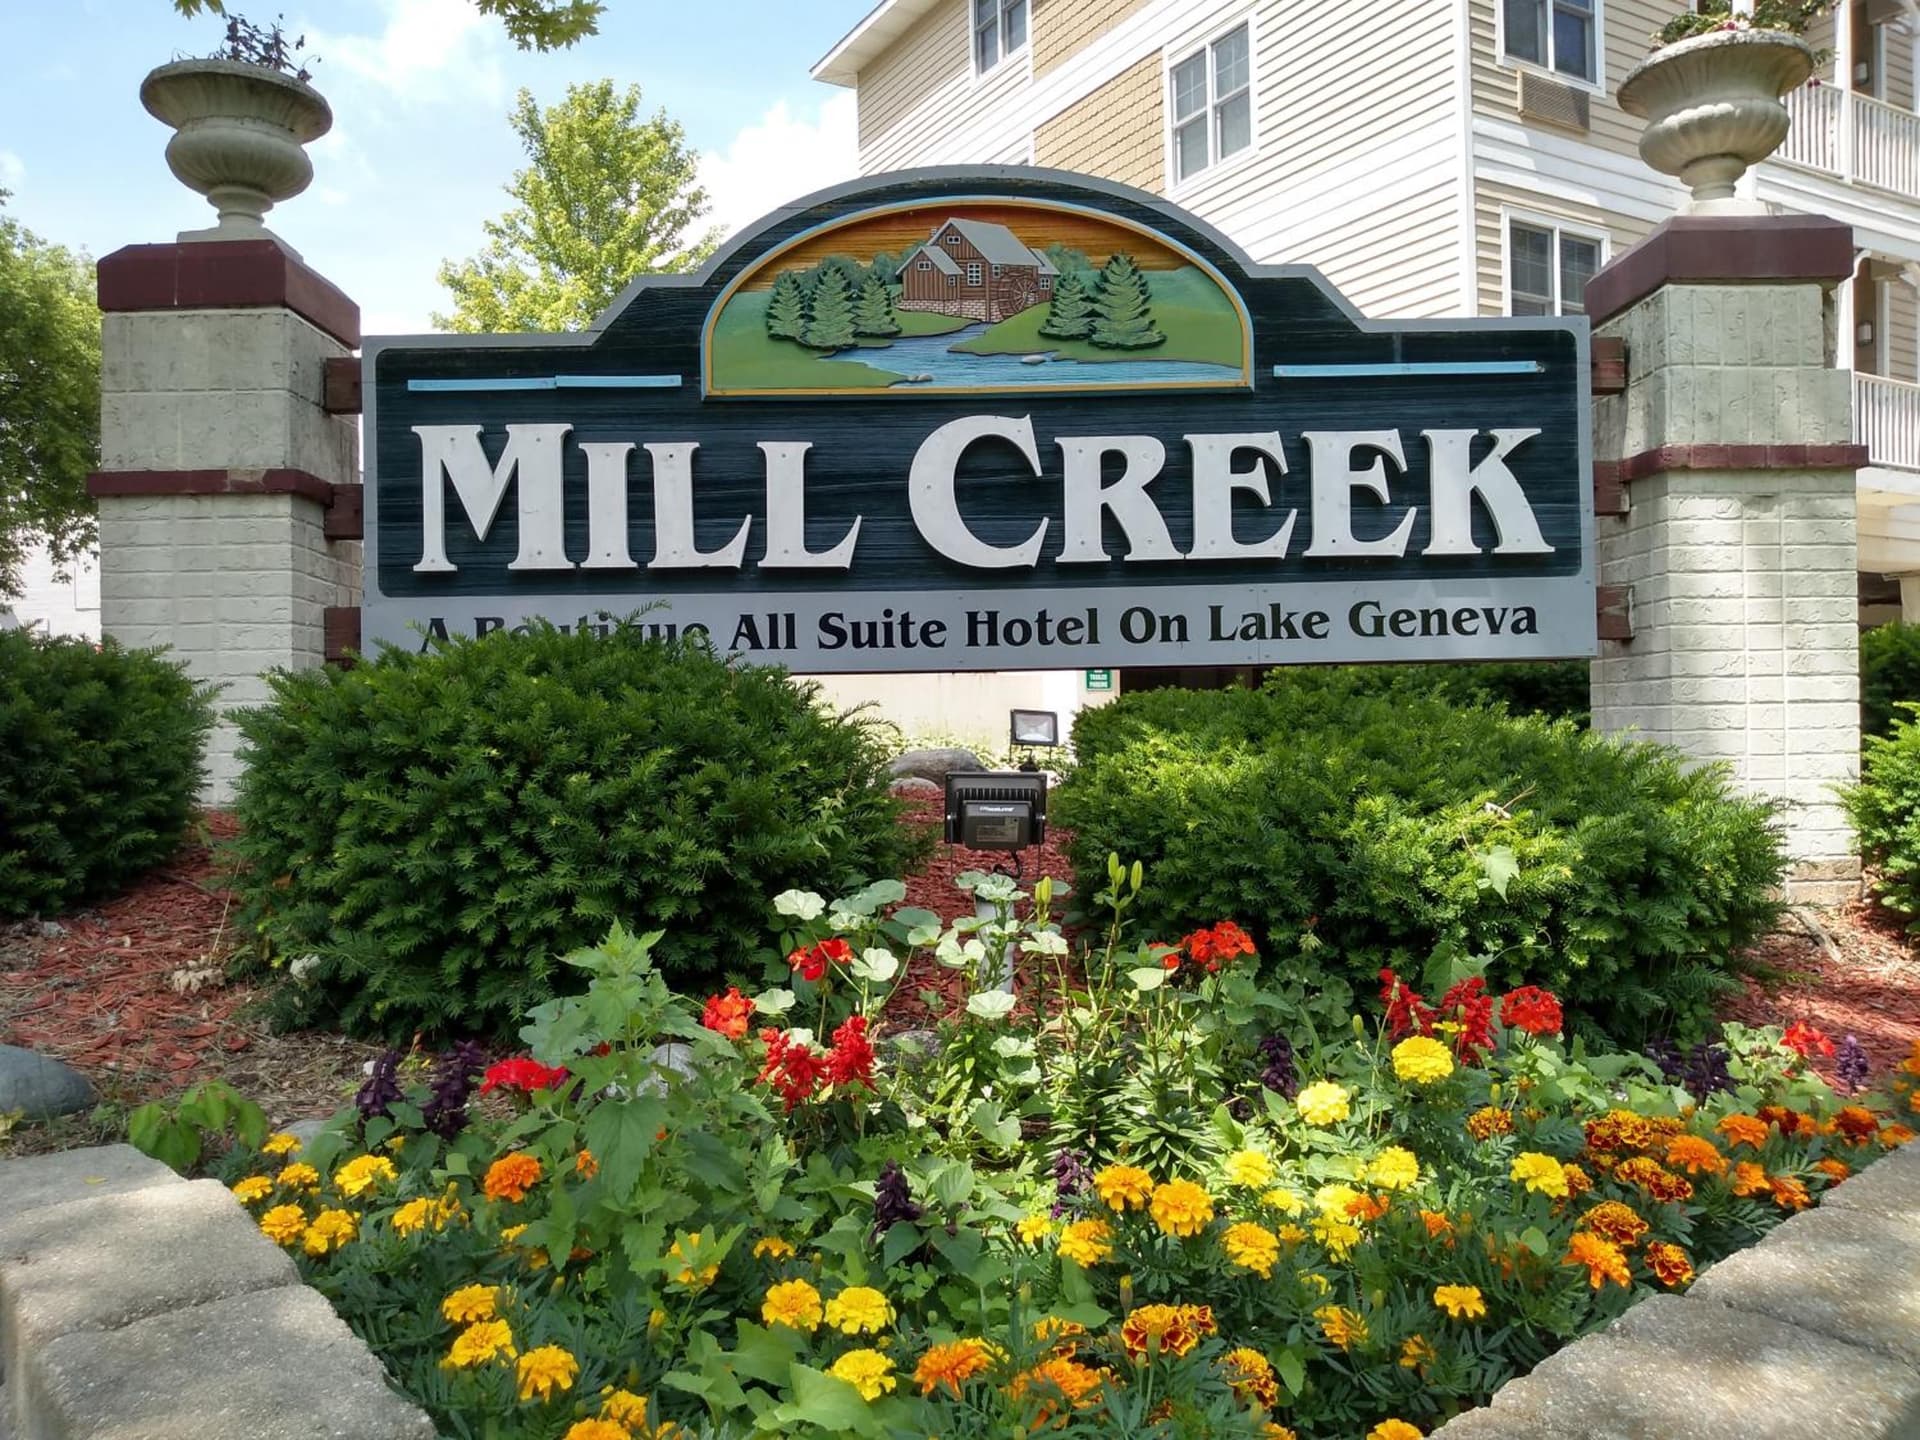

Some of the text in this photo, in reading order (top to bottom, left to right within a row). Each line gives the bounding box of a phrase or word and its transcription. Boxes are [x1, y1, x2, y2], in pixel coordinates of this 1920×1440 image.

[411, 413, 1555, 572] MILL CREEK
[418, 600, 1539, 654] A Btiue All Suite Hotel On Lake Geneva
